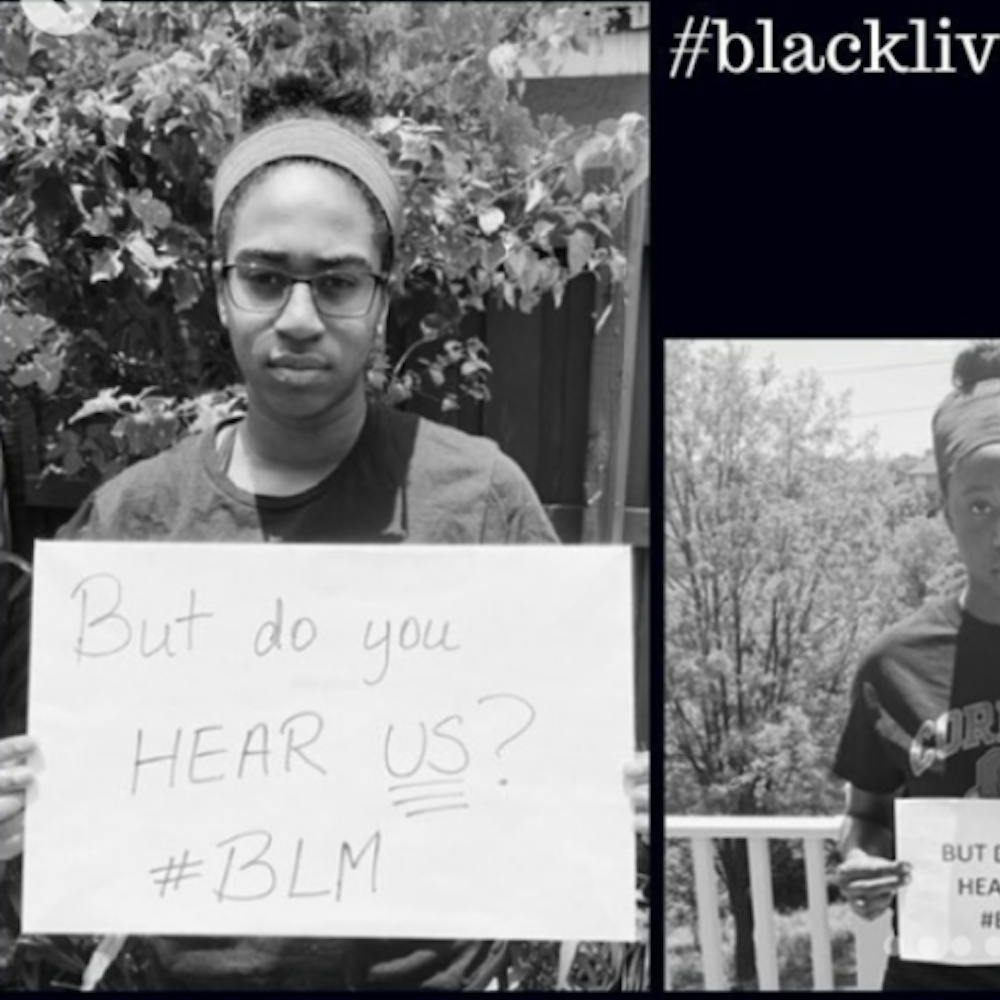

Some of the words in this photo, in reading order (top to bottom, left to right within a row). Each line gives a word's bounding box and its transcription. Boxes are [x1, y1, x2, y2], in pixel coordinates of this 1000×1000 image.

[71, 572, 215, 664] But
[254, 598, 318, 657] do
[362, 616, 461, 686] you
[131, 711, 328, 796] HEAR
[148, 830, 384, 903] #BLM
[942, 843, 987, 862] BUT
